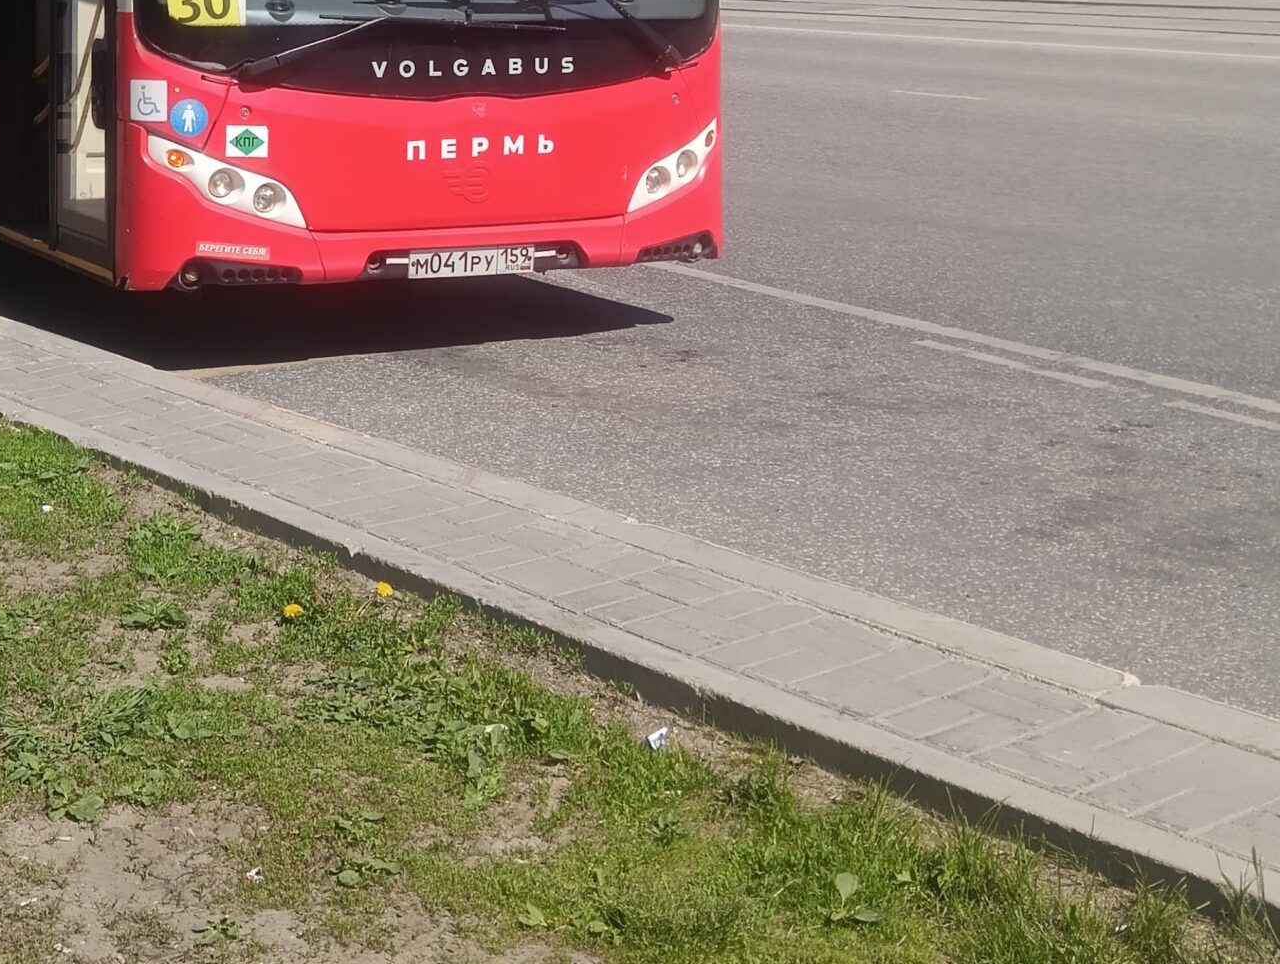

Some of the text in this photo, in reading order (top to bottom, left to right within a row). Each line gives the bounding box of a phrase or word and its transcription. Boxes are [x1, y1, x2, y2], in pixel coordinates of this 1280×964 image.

[371, 56, 575, 78] VOLGABUS
[235, 136, 258, 148] КПГ
[406, 134, 555, 161] ПЕРМЬ
[199, 243, 241, 254] БЕРЕГИТЕ
[415, 247, 529, 275] М041РУ 159
